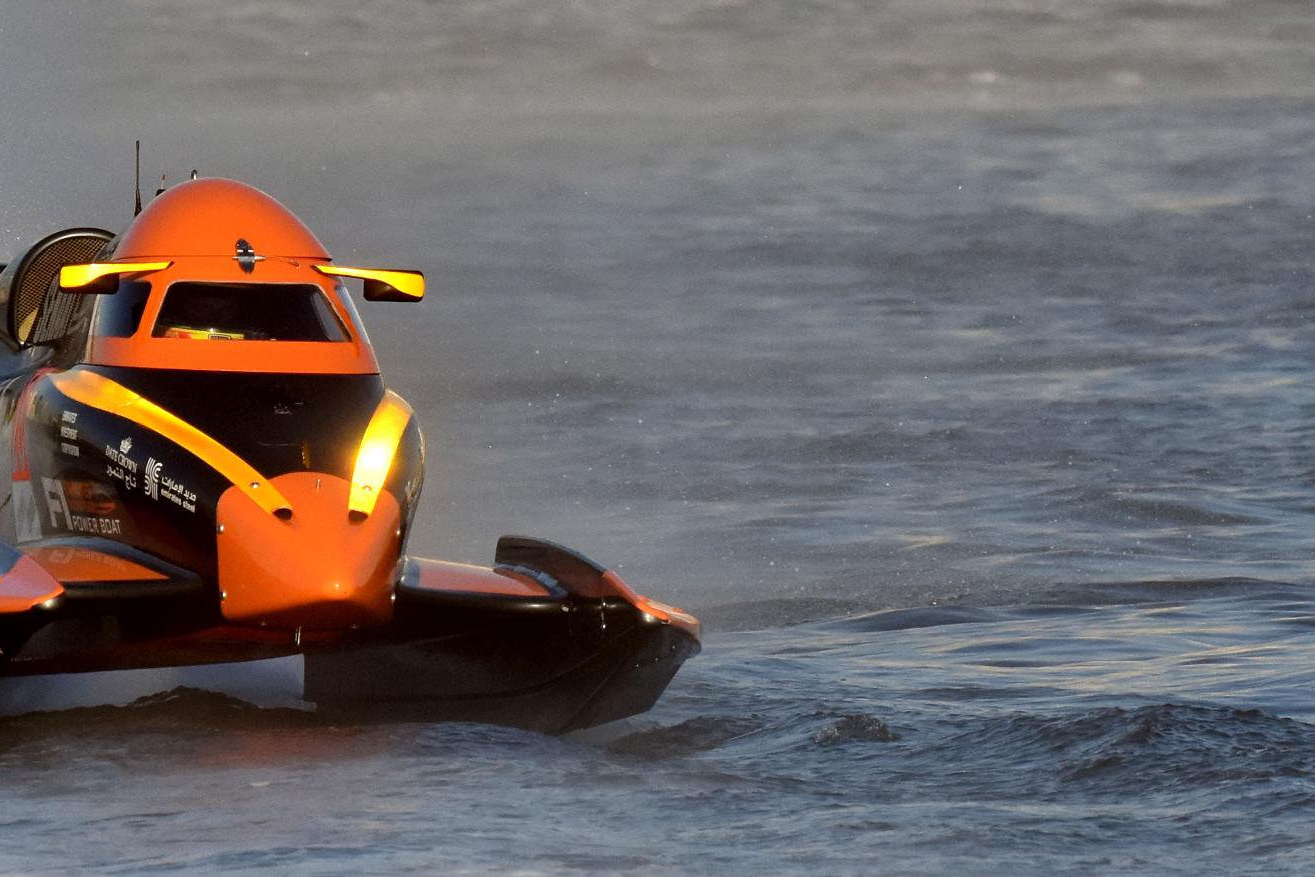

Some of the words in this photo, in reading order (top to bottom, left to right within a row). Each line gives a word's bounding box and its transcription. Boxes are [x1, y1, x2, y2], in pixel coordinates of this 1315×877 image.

[118, 453, 138, 473] CROWN
[160, 488, 182, 506] emirates
[182, 501, 196, 513] steel
[72, 515, 99, 533] POWER
[99, 518, 121, 535] BOAT
